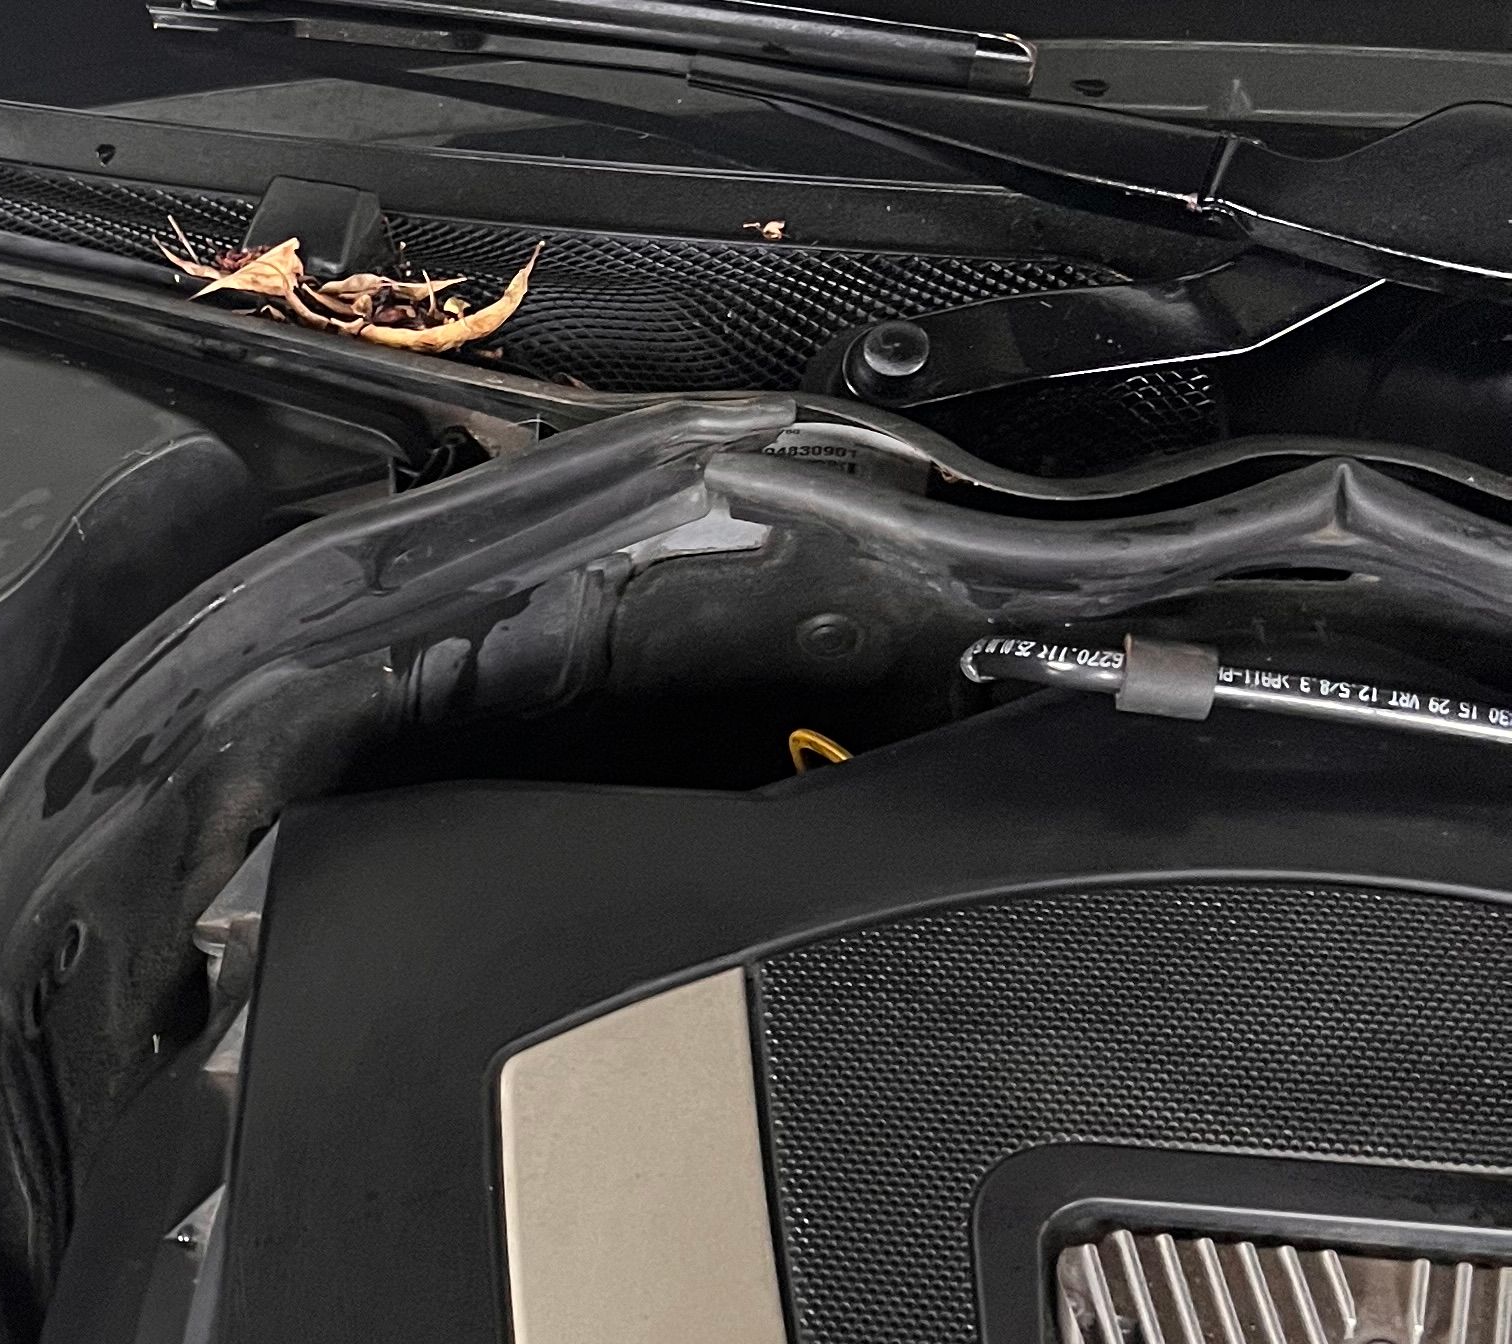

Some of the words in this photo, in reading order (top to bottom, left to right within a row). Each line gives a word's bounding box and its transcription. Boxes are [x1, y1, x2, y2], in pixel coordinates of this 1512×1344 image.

[1388, 690, 1419, 709] VRT
[1428, 697, 1451, 714] 29
[1457, 701, 1478, 719] 15
